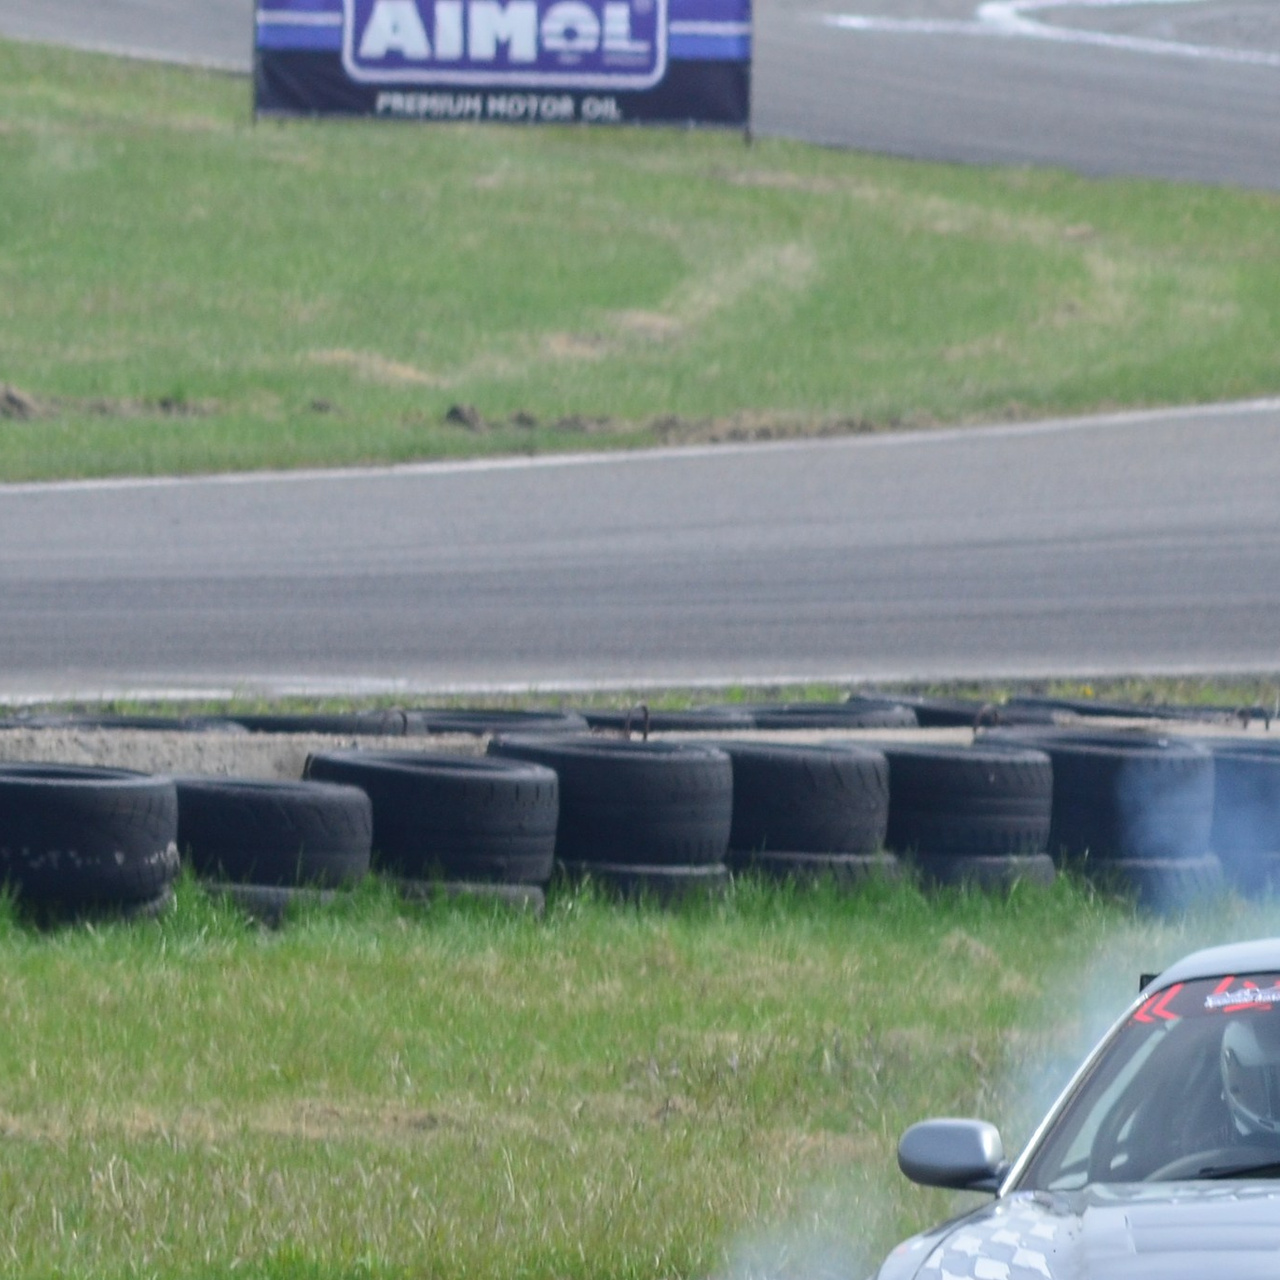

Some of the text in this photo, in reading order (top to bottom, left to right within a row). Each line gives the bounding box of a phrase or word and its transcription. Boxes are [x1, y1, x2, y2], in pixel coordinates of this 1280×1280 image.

[358, 0, 650, 65] AIMOL
[376, 92, 621, 120] PREMIUM MOTOR OIL
